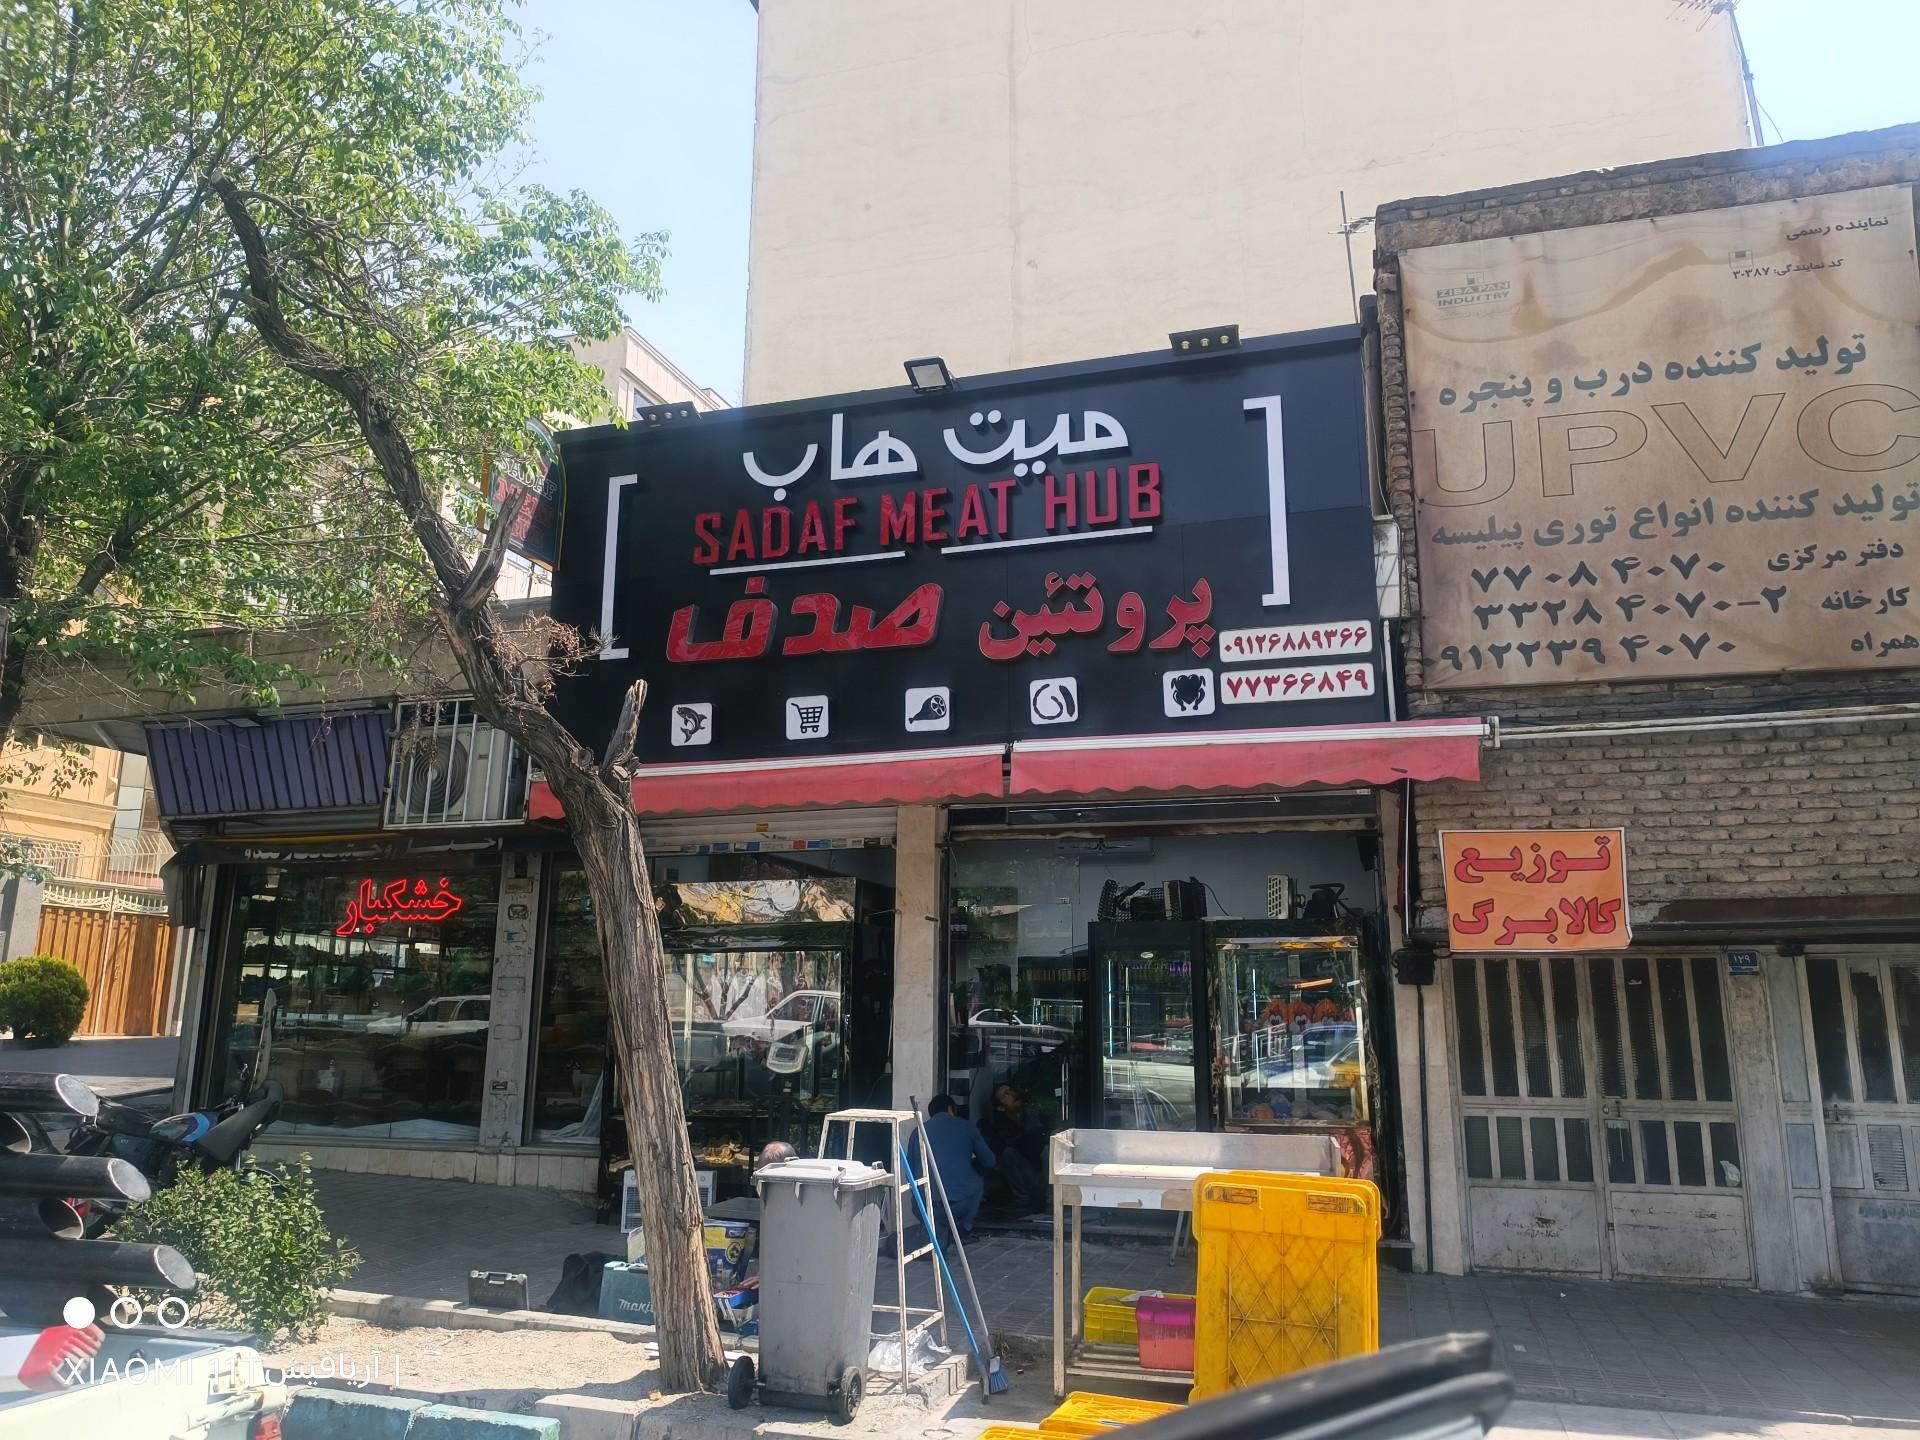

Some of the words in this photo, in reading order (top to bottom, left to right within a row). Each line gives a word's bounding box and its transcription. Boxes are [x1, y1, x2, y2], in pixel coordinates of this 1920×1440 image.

[1786, 225, 1831, 241] رسمی
[1835, 216, 1889, 232] نماینده
[1828, 258, 1844, 269] کد
[1665, 342, 1762, 381] کننده
[1775, 333, 1867, 376] تولید
[1438, 373, 1532, 413] پنجره
[1543, 377, 1564, 405] و
[1573, 357, 1653, 399] درب
[742, 411, 918, 502] هاب
[943, 408, 1128, 478] میت
[1412, 382, 1920, 508] UPVC
[691, 496, 858, 566] SADAF
[879, 478, 1018, 547] MEAT
[1043, 462, 1164, 529] HUB
[1628, 497, 1715, 540] انواع
[1725, 489, 1820, 524] کننده
[1833, 482, 1920, 523] تولید
[1431, 514, 1523, 551] پیلیسه
[1533, 505, 1617, 546] توری
[1767, 544, 1846, 573] مرکزی
[1856, 538, 1905, 569] دفتر
[664, 575, 945, 664] صدف
[978, 571, 1217, 661] پروتئین
[1821, 585, 1911, 615] کارخانه
[1224, 626, 1368, 656] ۰۹۱۲۶۸۸۹۳۶۶
[1850, 630, 1920, 659] همراه
[1226, 669, 1369, 699] ۷۷۳۶۶۸۴۹
[1454, 836, 1611, 884] توزیع
[336, 877, 463, 936] خشکبار
[618, 1298, 654, 1315] maki
